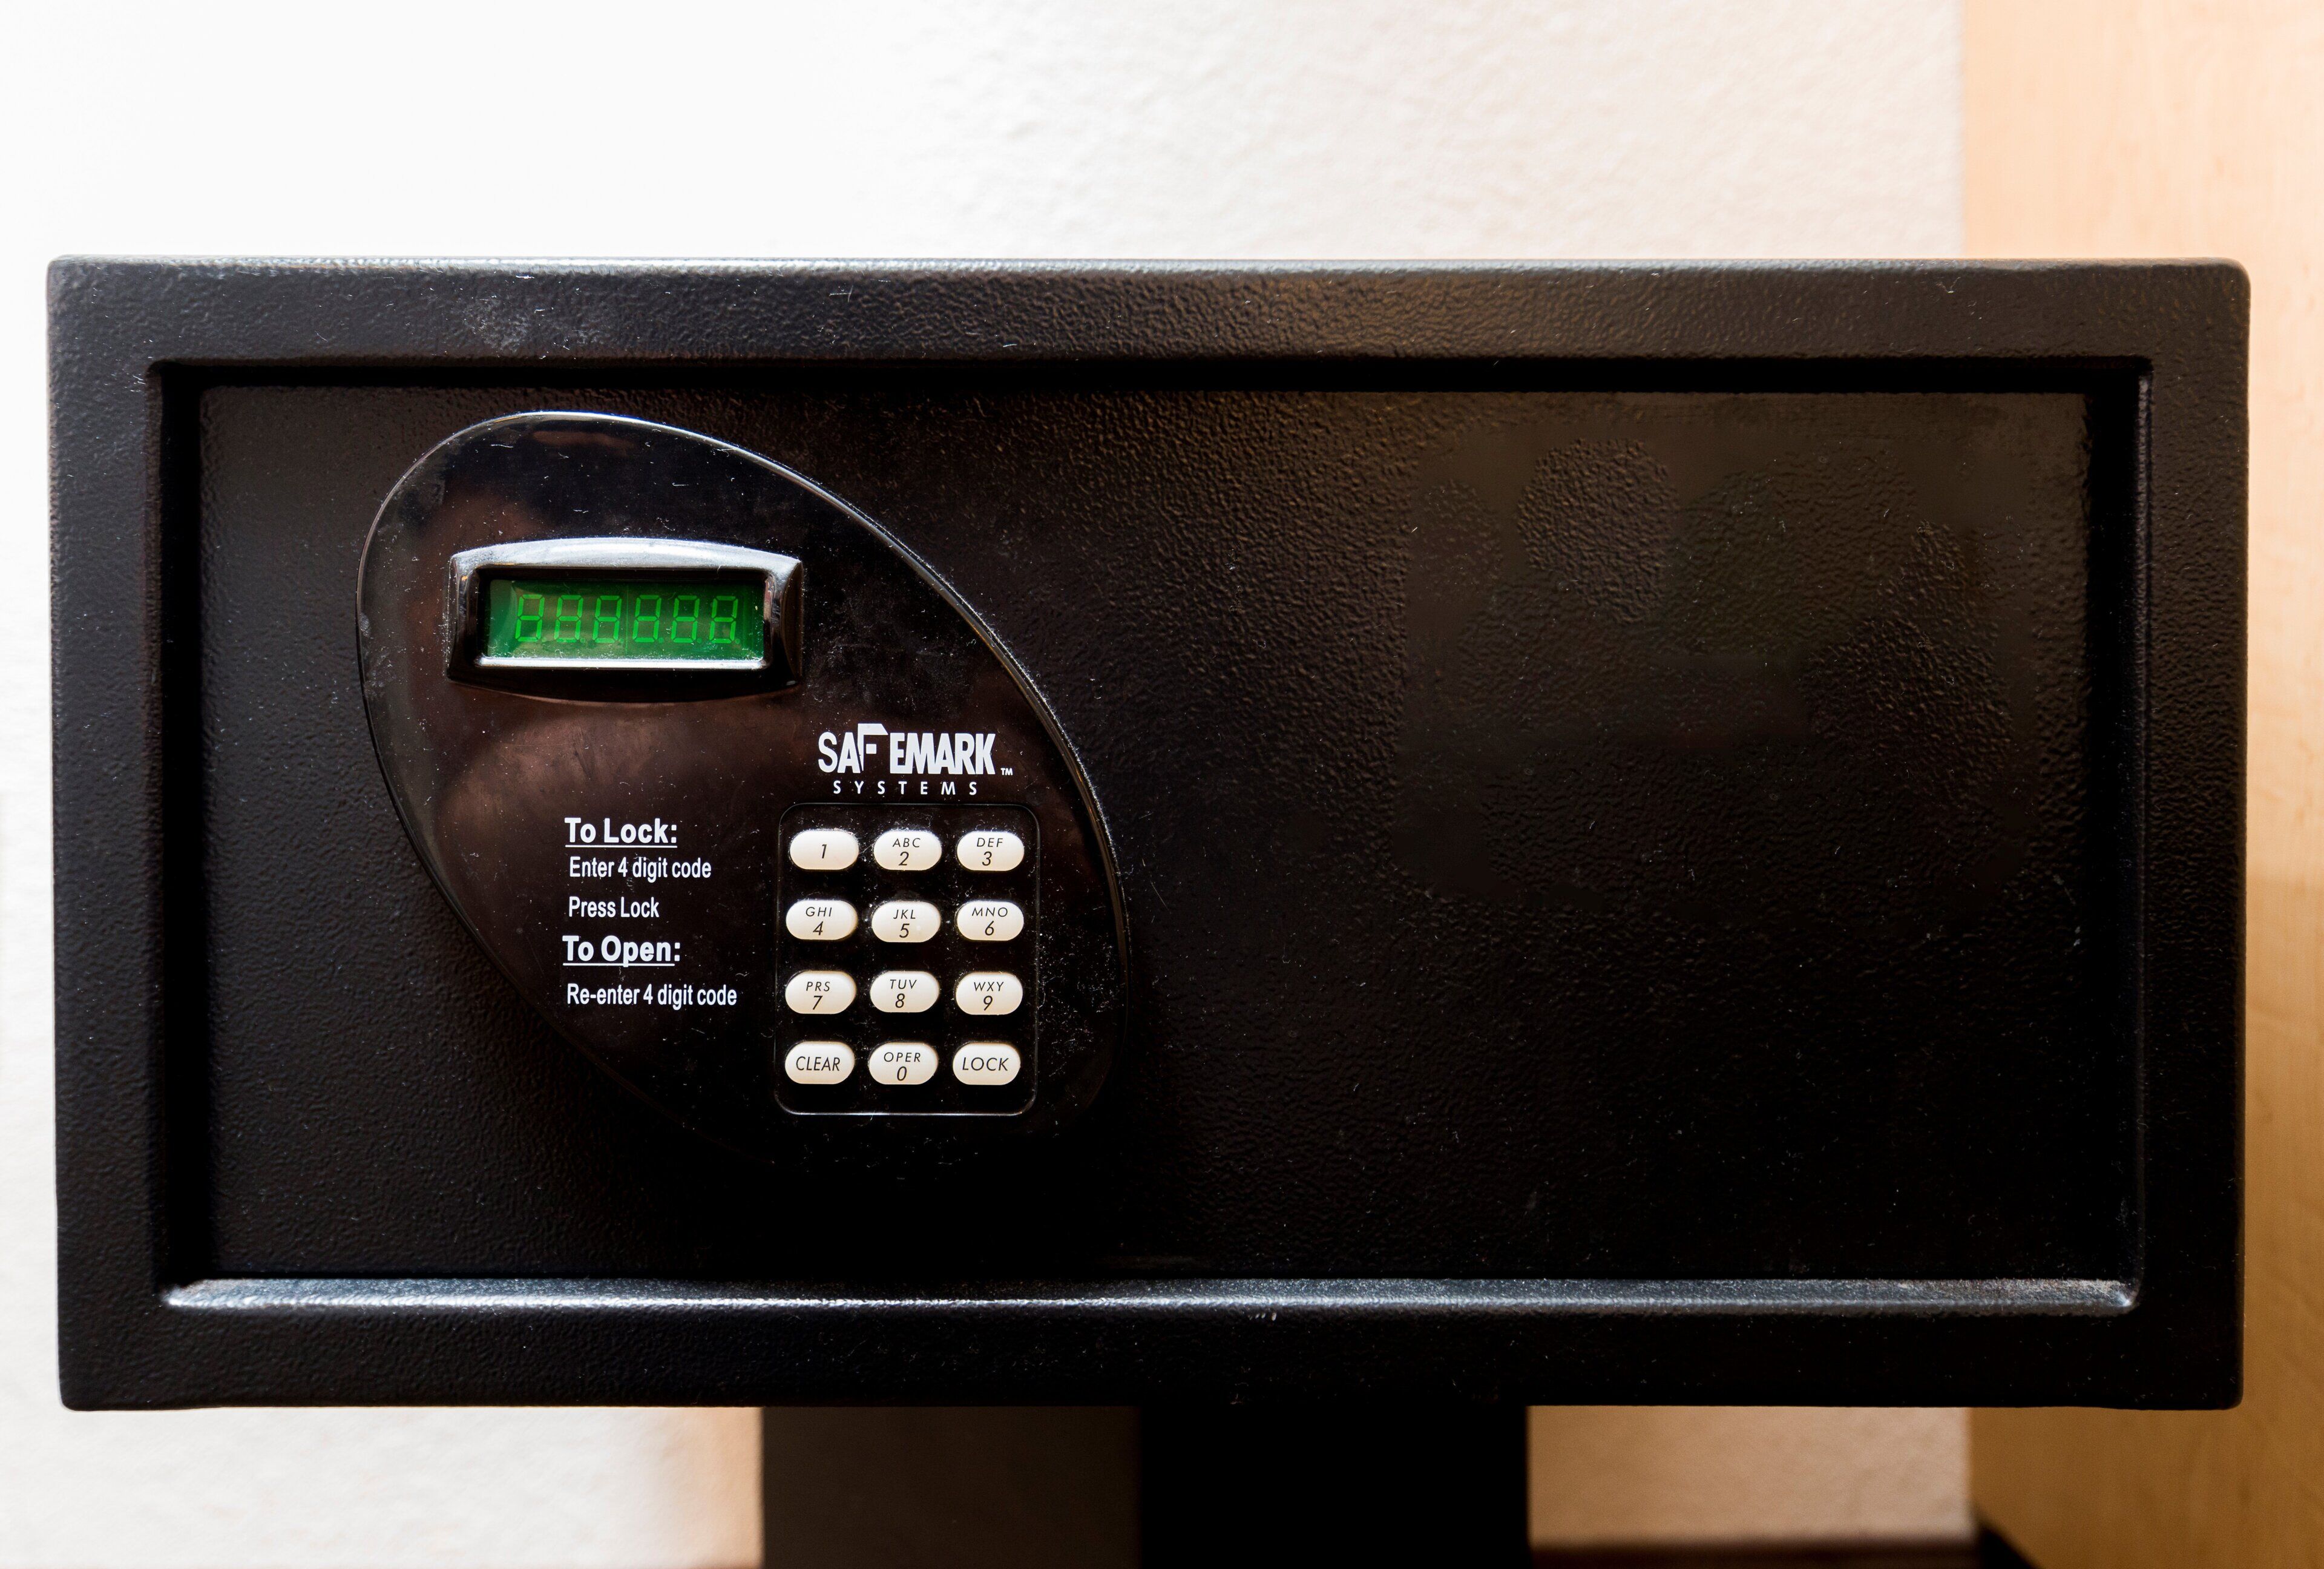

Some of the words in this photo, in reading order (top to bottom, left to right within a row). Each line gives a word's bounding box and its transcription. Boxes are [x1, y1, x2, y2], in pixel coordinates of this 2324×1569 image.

[818, 723, 996, 775] SAFEMARK
[833, 780, 977, 795] SYSTEMS
[564, 817, 596, 843] To
[603, 817, 677, 844] Lock:
[892, 838, 921, 848] ABC
[976, 837, 1003, 847] DEF
[821, 844, 827, 859] 1
[898, 851, 910, 866] 2
[982, 851, 993, 866] 3
[570, 856, 615, 878] Enter
[617, 857, 628, 878] 4
[632, 857, 668, 883] digit
[672, 857, 712, 878] code
[569, 896, 616, 918] Press
[620, 896, 660, 918] Lock
[806, 906, 832, 917] GHI
[893, 909, 916, 919] JKL
[971, 907, 1008, 918] MNO
[812, 921, 824, 936] 4
[899, 923, 910, 939] 5
[984, 920, 994, 936] 6
[562, 935, 594, 962] To
[600, 935, 680, 968] Open:
[806, 981, 830, 992] PRS
[890, 979, 917, 990] TUV
[973, 981, 1004, 992] WXY
[567, 983, 640, 1005] Re-enter
[643, 983, 654, 1005] 4
[657, 984, 694, 1011] digit
[697, 984, 737, 1005] code
[812, 995, 823, 1010] 7
[894, 993, 905, 1008] 8
[983, 995, 993, 1011] 9
[796, 1056, 841, 1071] CLEAR
[884, 1051, 921, 1062] OPER
[962, 1057, 1009, 1071] LOCK
[896, 1066, 907, 1082] 0
